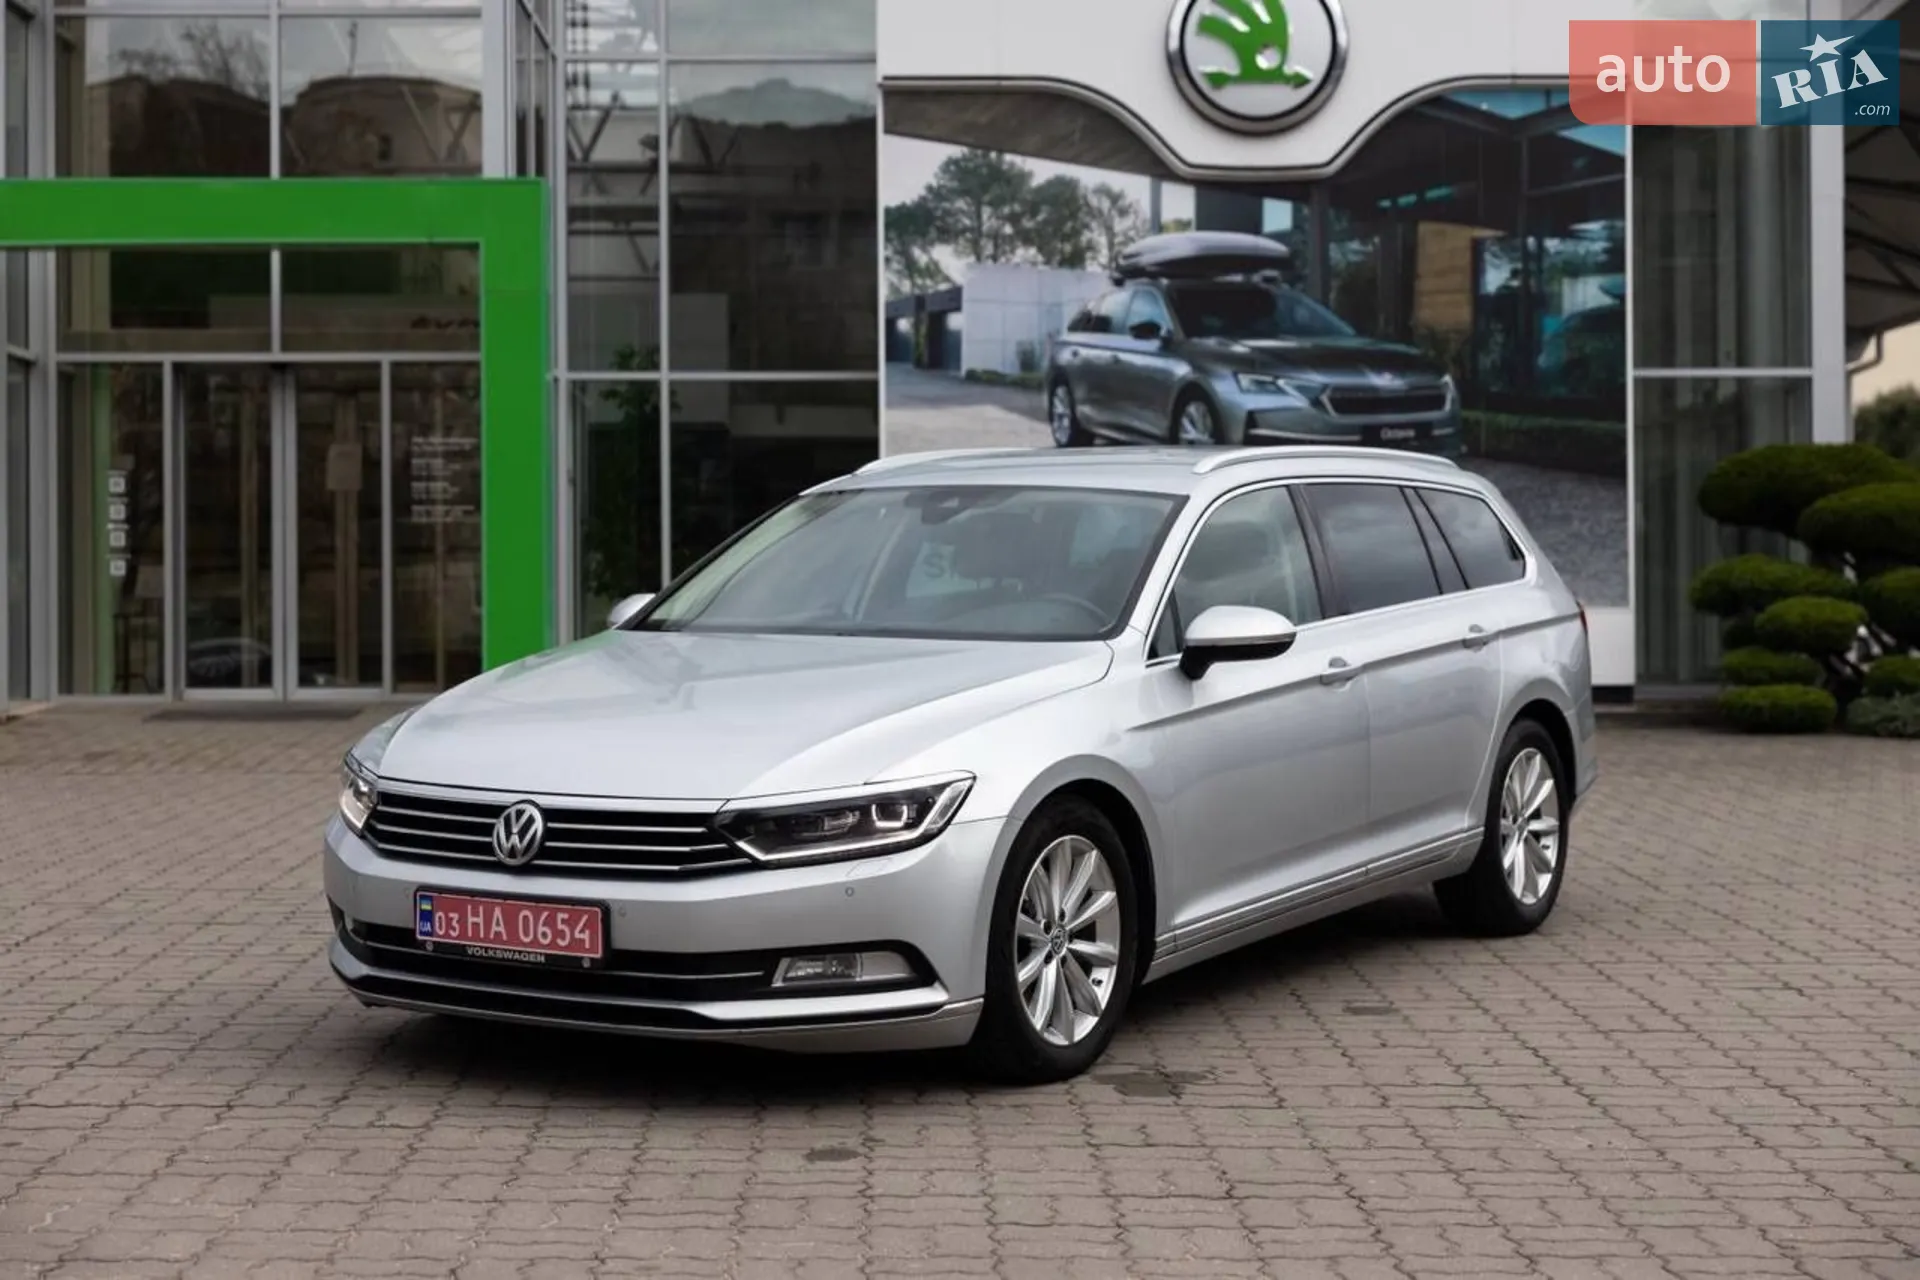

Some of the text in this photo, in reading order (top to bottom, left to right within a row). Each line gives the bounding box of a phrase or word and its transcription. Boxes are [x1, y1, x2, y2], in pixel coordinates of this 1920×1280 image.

[435, 904, 591, 949] 03 HA 0654
[466, 946, 546, 962] VOLKSWAGEN
